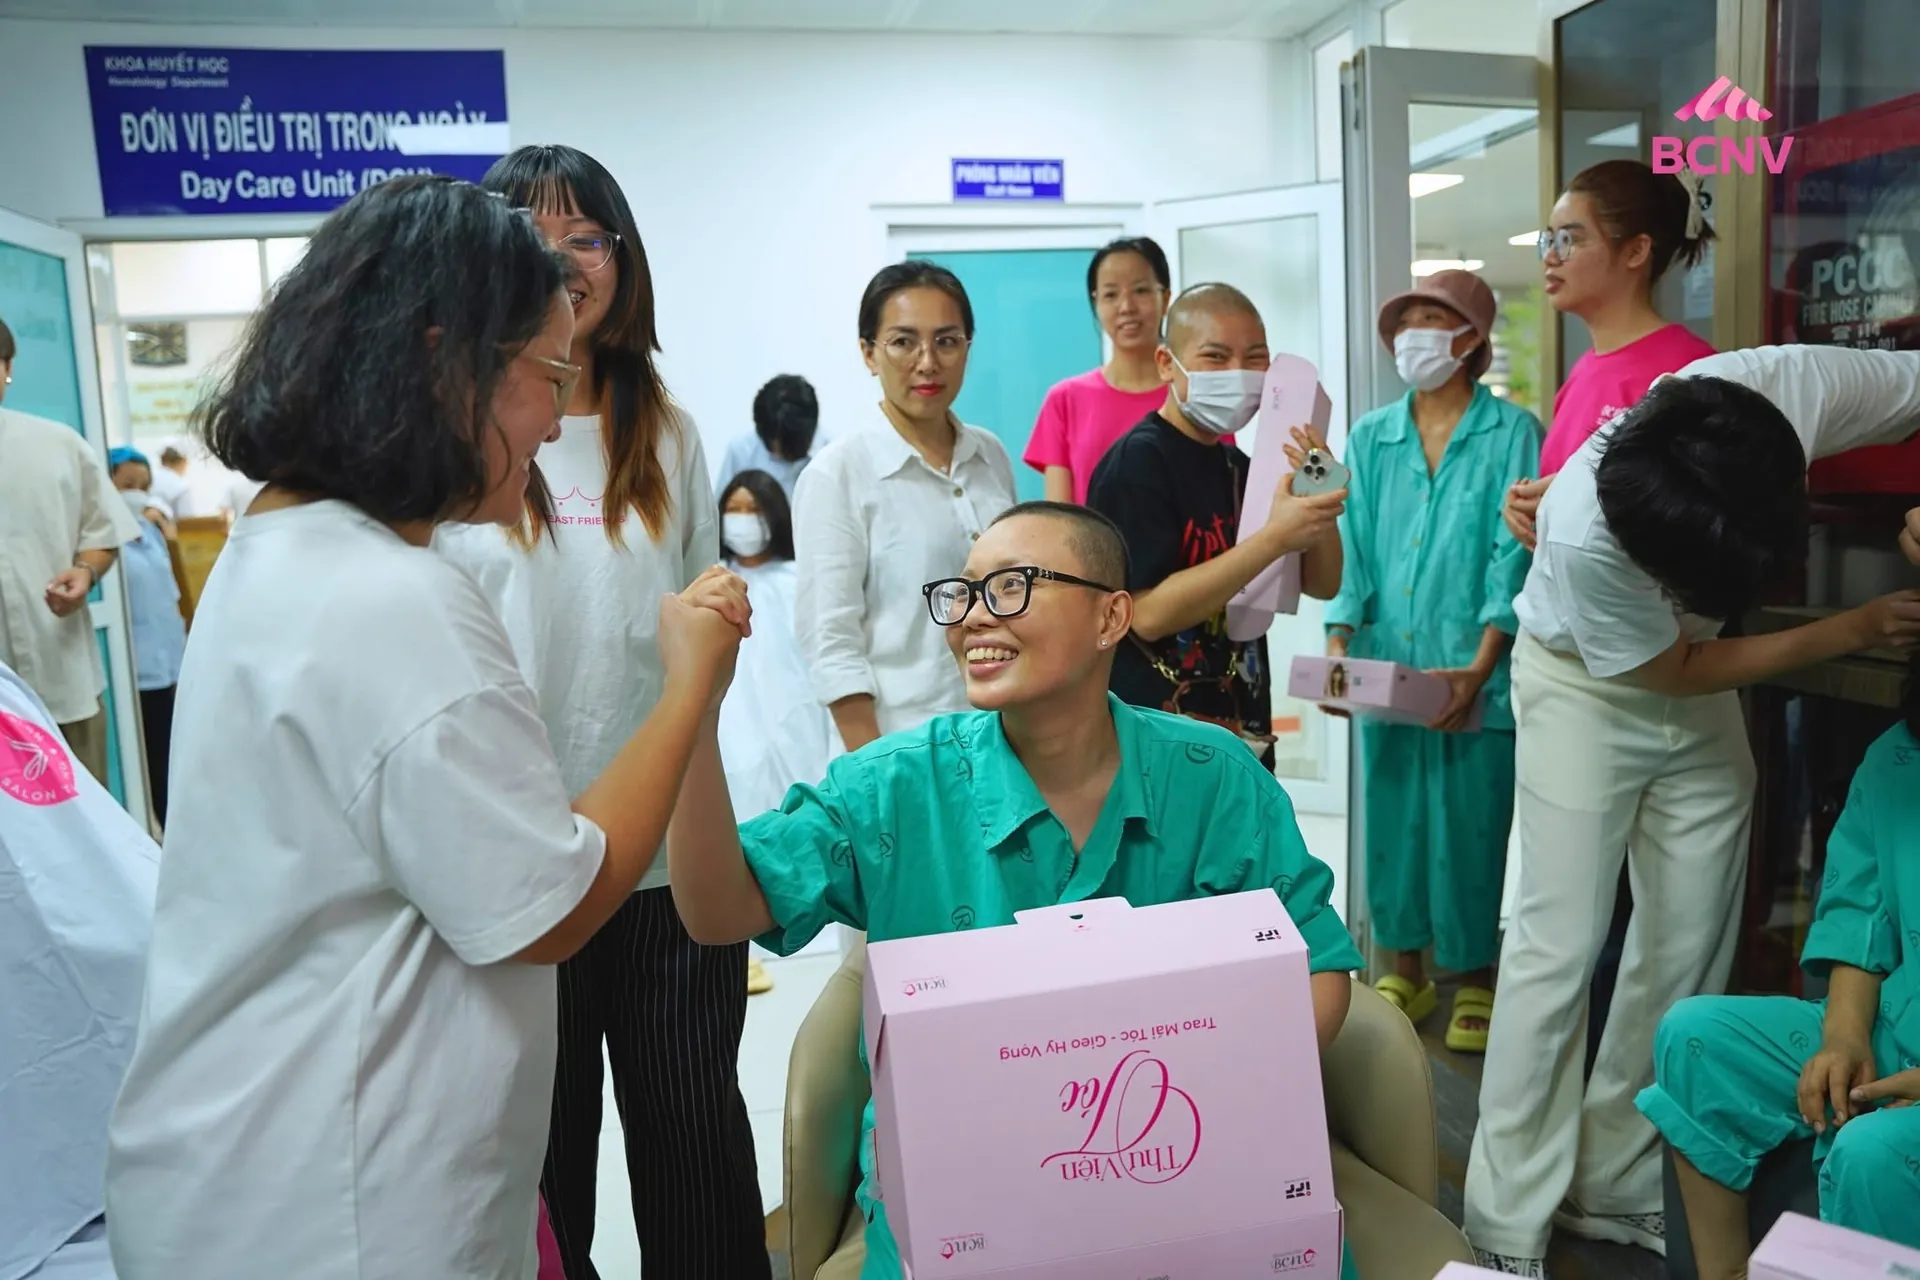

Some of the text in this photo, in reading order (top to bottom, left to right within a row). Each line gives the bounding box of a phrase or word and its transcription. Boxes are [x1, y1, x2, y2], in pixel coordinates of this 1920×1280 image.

[104, 51, 229, 74] KHOA HUYẾT HỌC
[121, 106, 178, 152] ĐƠN
[182, 112, 210, 160] VỊ
[214, 95, 275, 152] ĐIỀU
[279, 112, 323, 160] TRỊ
[180, 171, 232, 203] Day
[235, 170, 297, 199] Care
[302, 168, 356, 198] Unit
[1151, 1023, 1178, 1040] Mái
[1183, 1016, 1217, 1031] Trao
[1071, 1035, 1106, 1050] Gieo
[1121, 1028, 1148, 1043] Tóc
[1000, 1043, 1042, 1060] Vọng
[1046, 1040, 1067, 1054] Hy
[1060, 1145, 1182, 1182] Thư Viện
